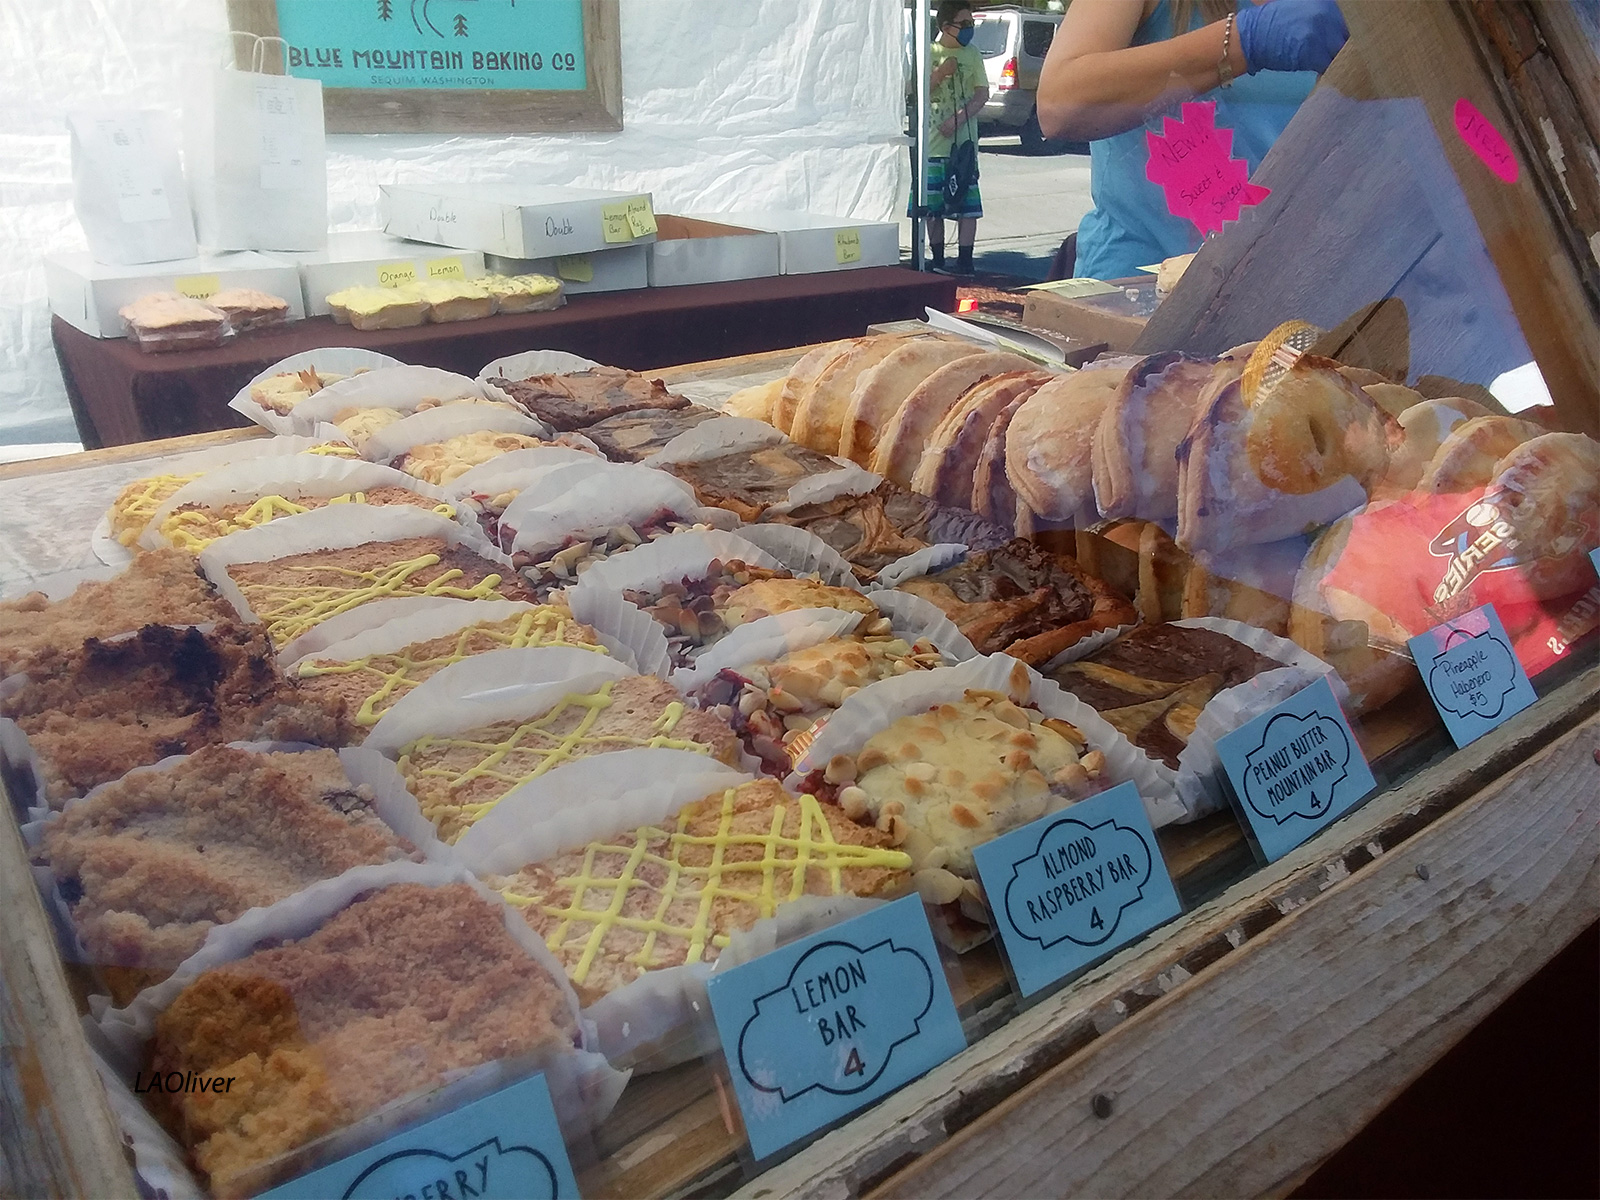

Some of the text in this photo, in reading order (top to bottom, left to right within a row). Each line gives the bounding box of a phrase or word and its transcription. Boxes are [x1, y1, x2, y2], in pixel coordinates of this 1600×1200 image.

[288, 46, 576, 71] BLUE MOUNTAIN BAKING CO
[422, 76, 495, 85] WASHINGTON
[1180, 174, 1212, 207] Sweet
[429, 207, 458, 224] Double
[545, 216, 575, 238] Double
[603, 210, 627, 221] Lemon
[608, 223, 621, 234] Bar
[380, 271, 415, 283] Orange
[430, 265, 460, 276] Lemon
[1438, 650, 1489, 678] Pineapple
[1469, 691, 1488, 707] $5
[1252, 725, 1328, 785] PEANUT BUTTER
[1266, 749, 1337, 808] MOUNTAIN BAR
[1310, 790, 1322, 809] 4
[1042, 836, 1097, 880] ALMOND
[1026, 853, 1138, 924] RASPBERRY BAR
[1090, 906, 1104, 930] 4
[791, 958, 867, 1015] LEMON
[817, 1004, 867, 1046] BAR
[843, 1047, 866, 1077] 4
